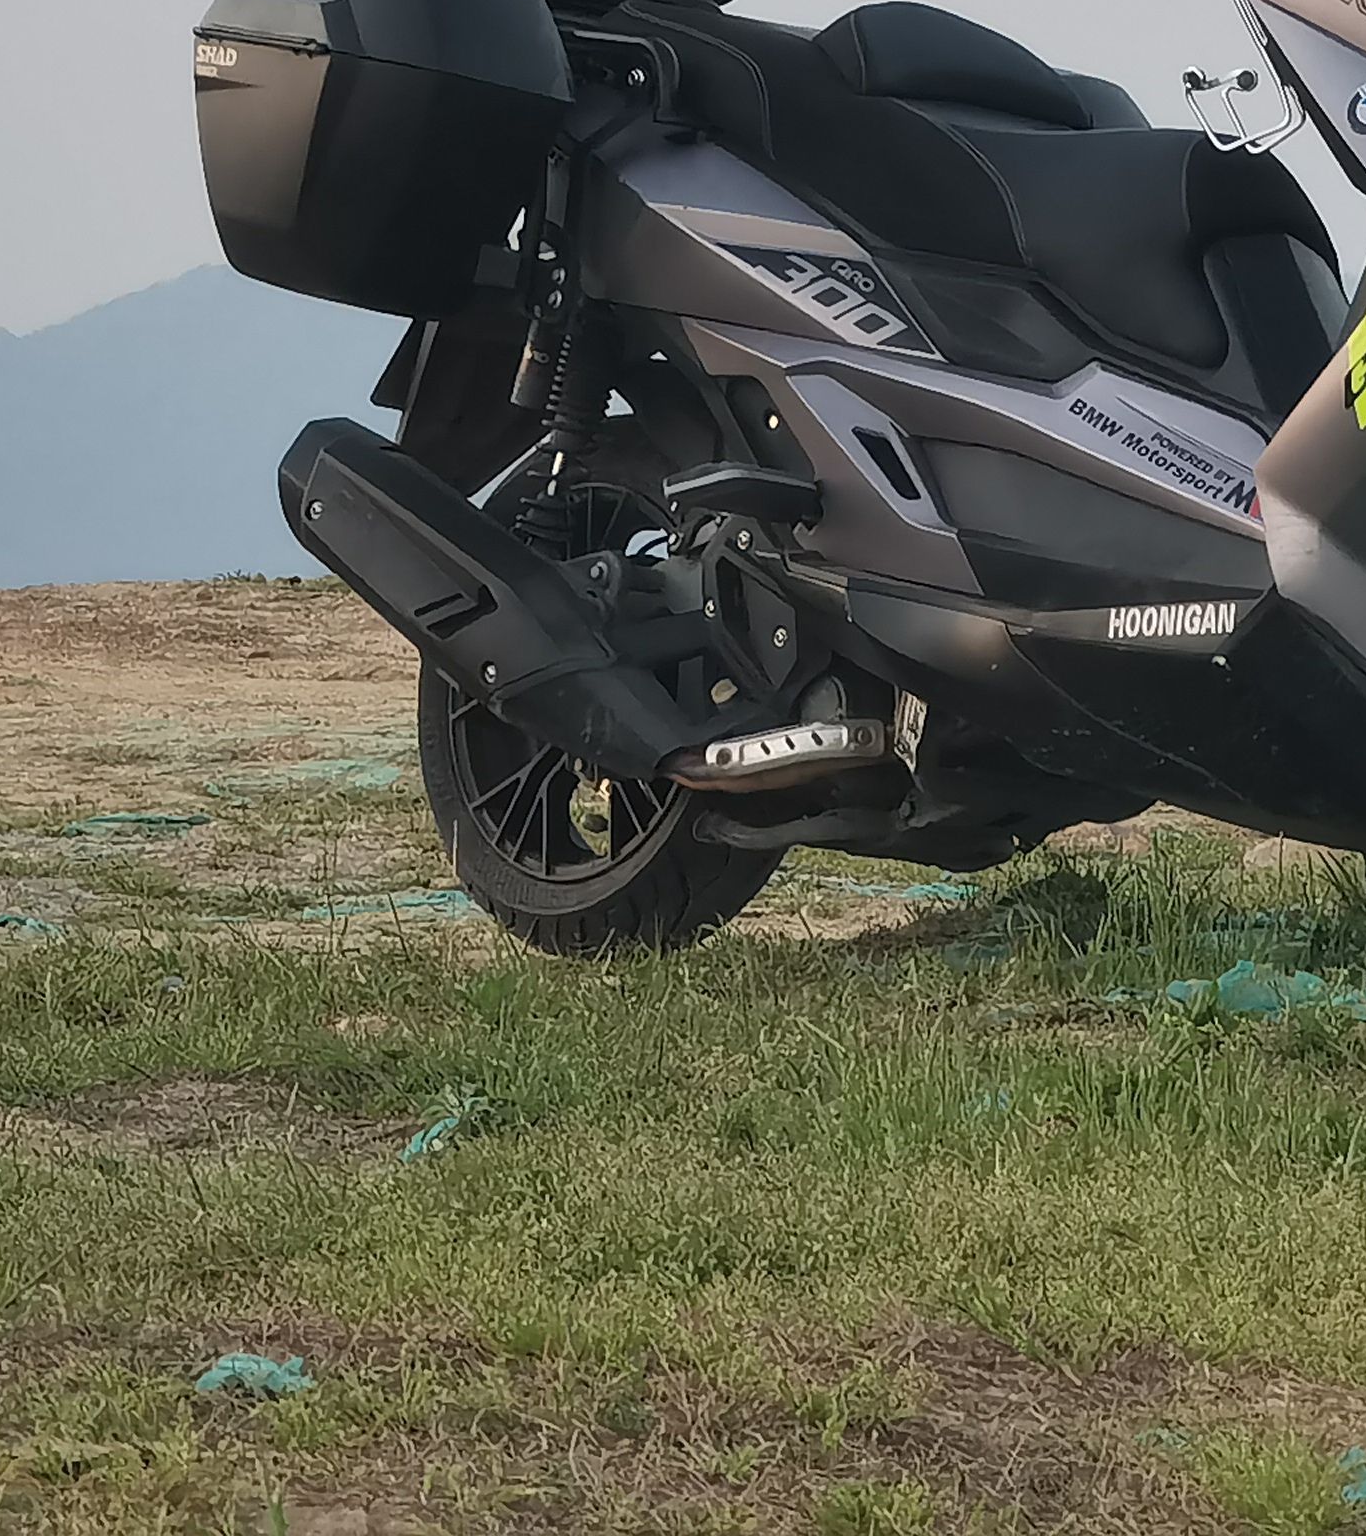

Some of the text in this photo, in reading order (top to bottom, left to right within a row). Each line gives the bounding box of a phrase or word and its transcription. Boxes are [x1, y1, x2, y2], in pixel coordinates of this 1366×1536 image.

[196, 44, 238, 66] SHAD
[751, 255, 908, 347] 300
[1068, 398, 1223, 500] BMW Motorsport
[1150, 431, 1236, 485] POWERED BY
[1108, 602, 1236, 639] HOONIGAN
